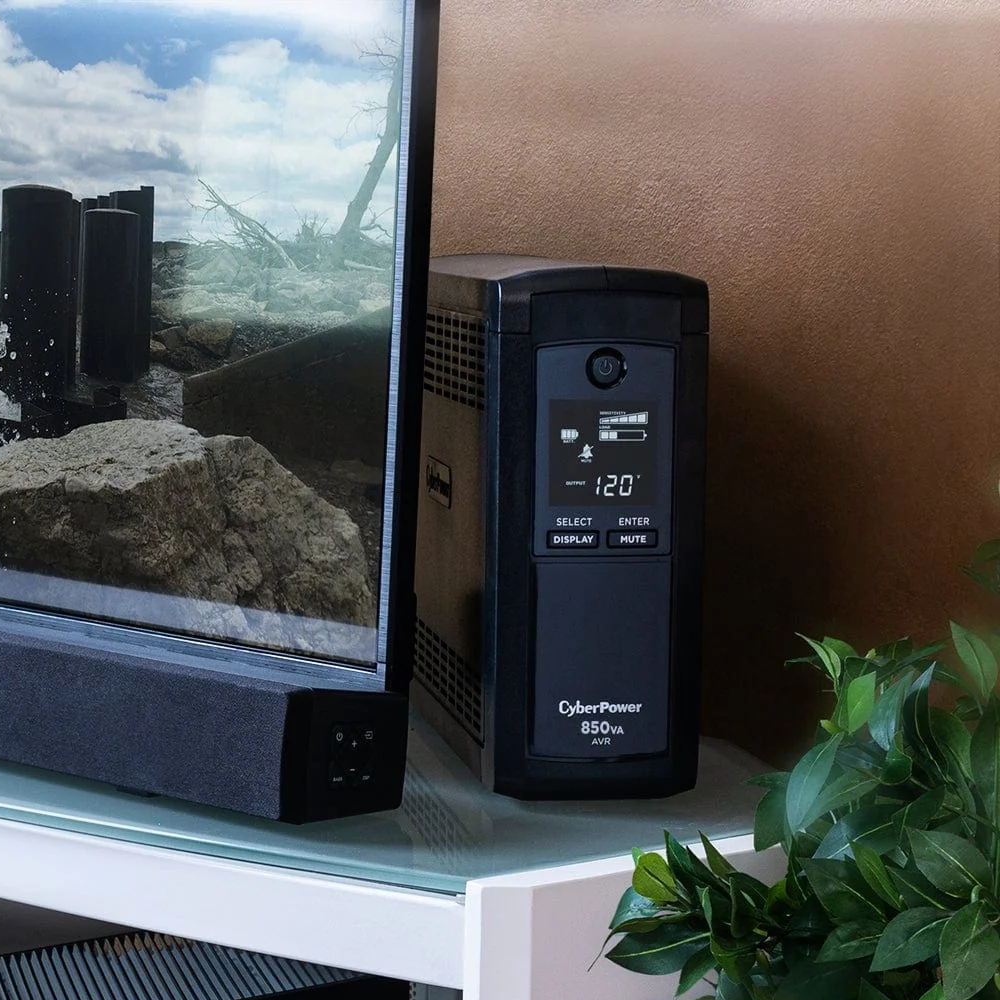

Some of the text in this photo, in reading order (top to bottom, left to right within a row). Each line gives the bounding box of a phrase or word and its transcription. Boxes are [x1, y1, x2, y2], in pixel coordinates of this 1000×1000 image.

[595, 474, 634, 497] 120
[556, 517, 593, 526] SELECT
[618, 517, 650, 526] ENTER
[553, 535, 594, 544] DISPLAY
[620, 535, 647, 544] MUTE
[558, 699, 643, 717] CyberPower
[591, 737, 611, 746] AVR
